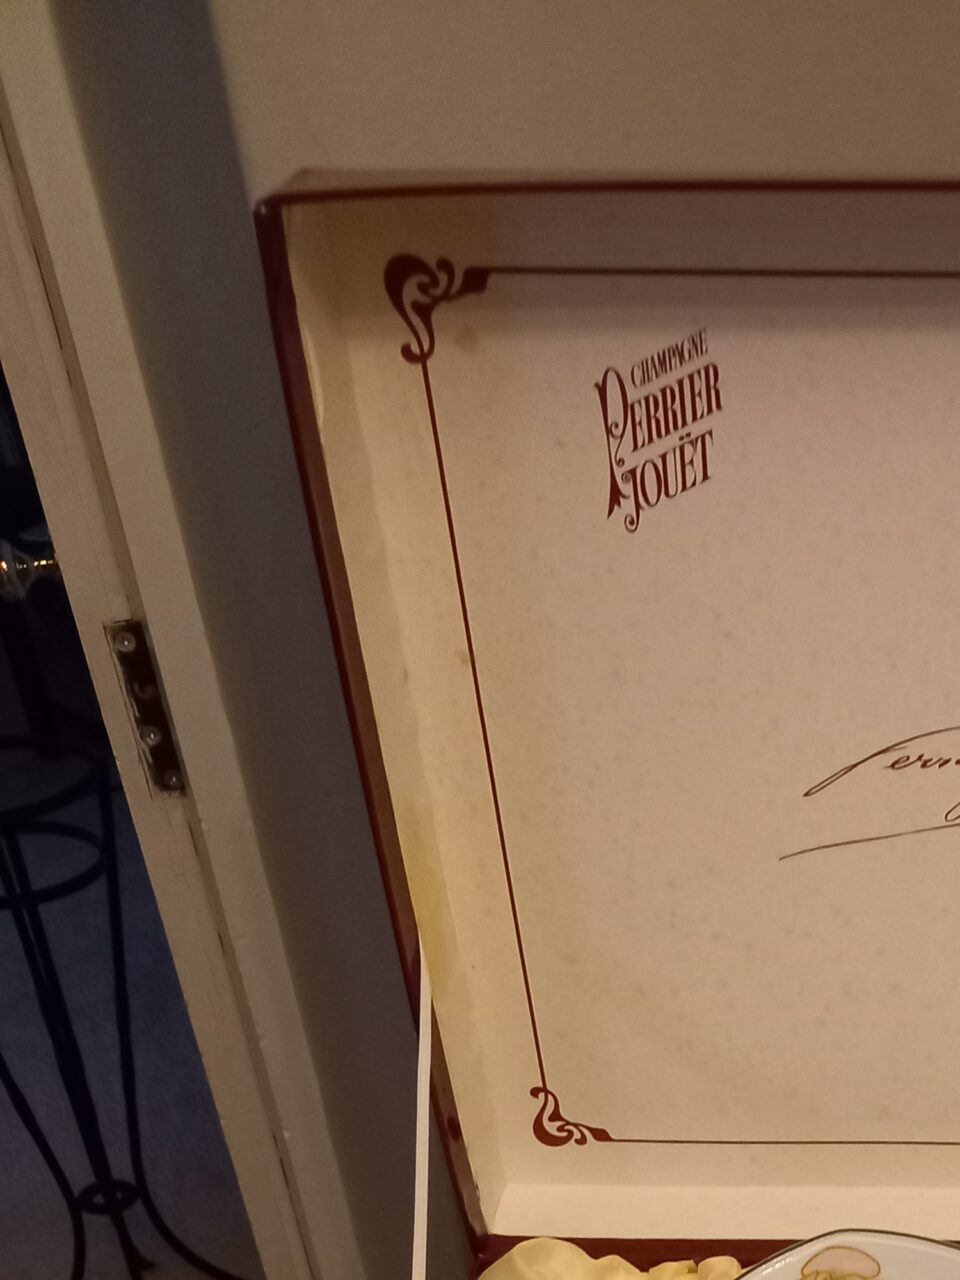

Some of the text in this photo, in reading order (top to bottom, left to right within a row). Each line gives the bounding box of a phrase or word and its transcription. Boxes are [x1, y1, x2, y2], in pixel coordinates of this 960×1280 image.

[630, 327, 709, 388] CHAMPAGNE
[594, 362, 723, 519] PERRIER
[621, 430, 714, 534] JOUËT
